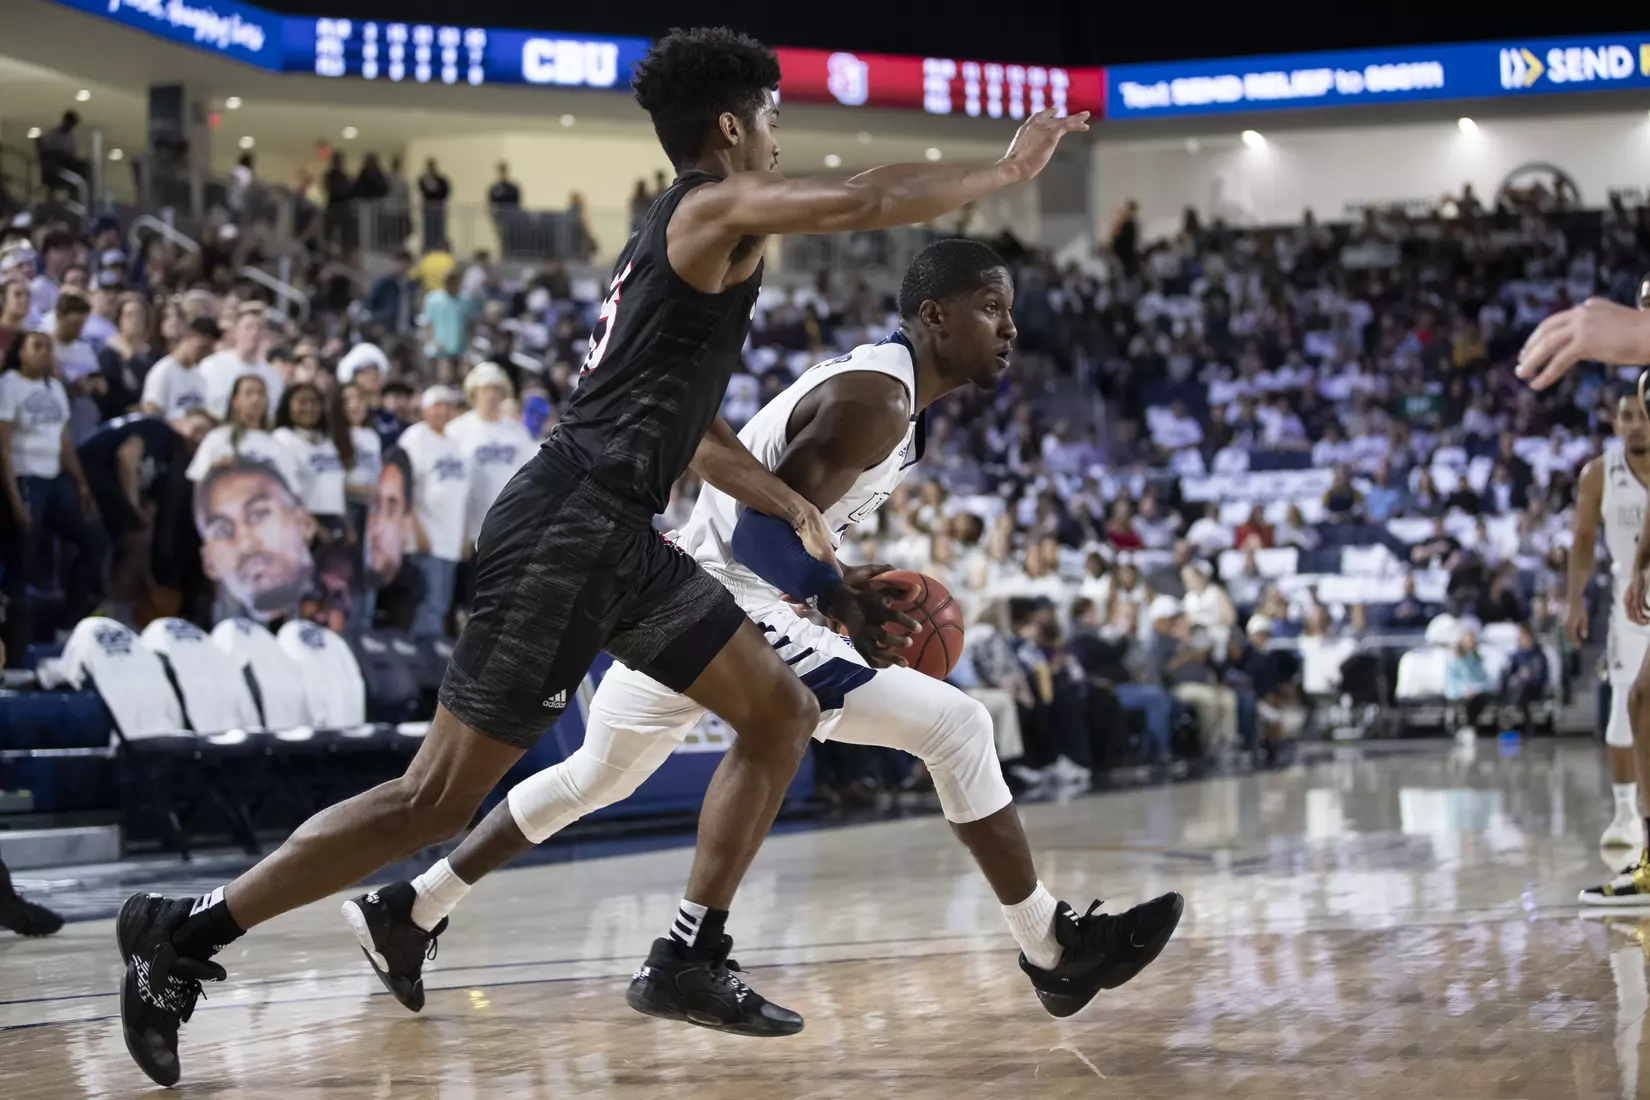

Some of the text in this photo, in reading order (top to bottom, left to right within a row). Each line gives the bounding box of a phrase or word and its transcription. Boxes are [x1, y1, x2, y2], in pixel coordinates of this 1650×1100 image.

[523, 38, 619, 88] CBU
[1546, 45, 1635, 83] SEND
[542, 700, 567, 709] adidas
